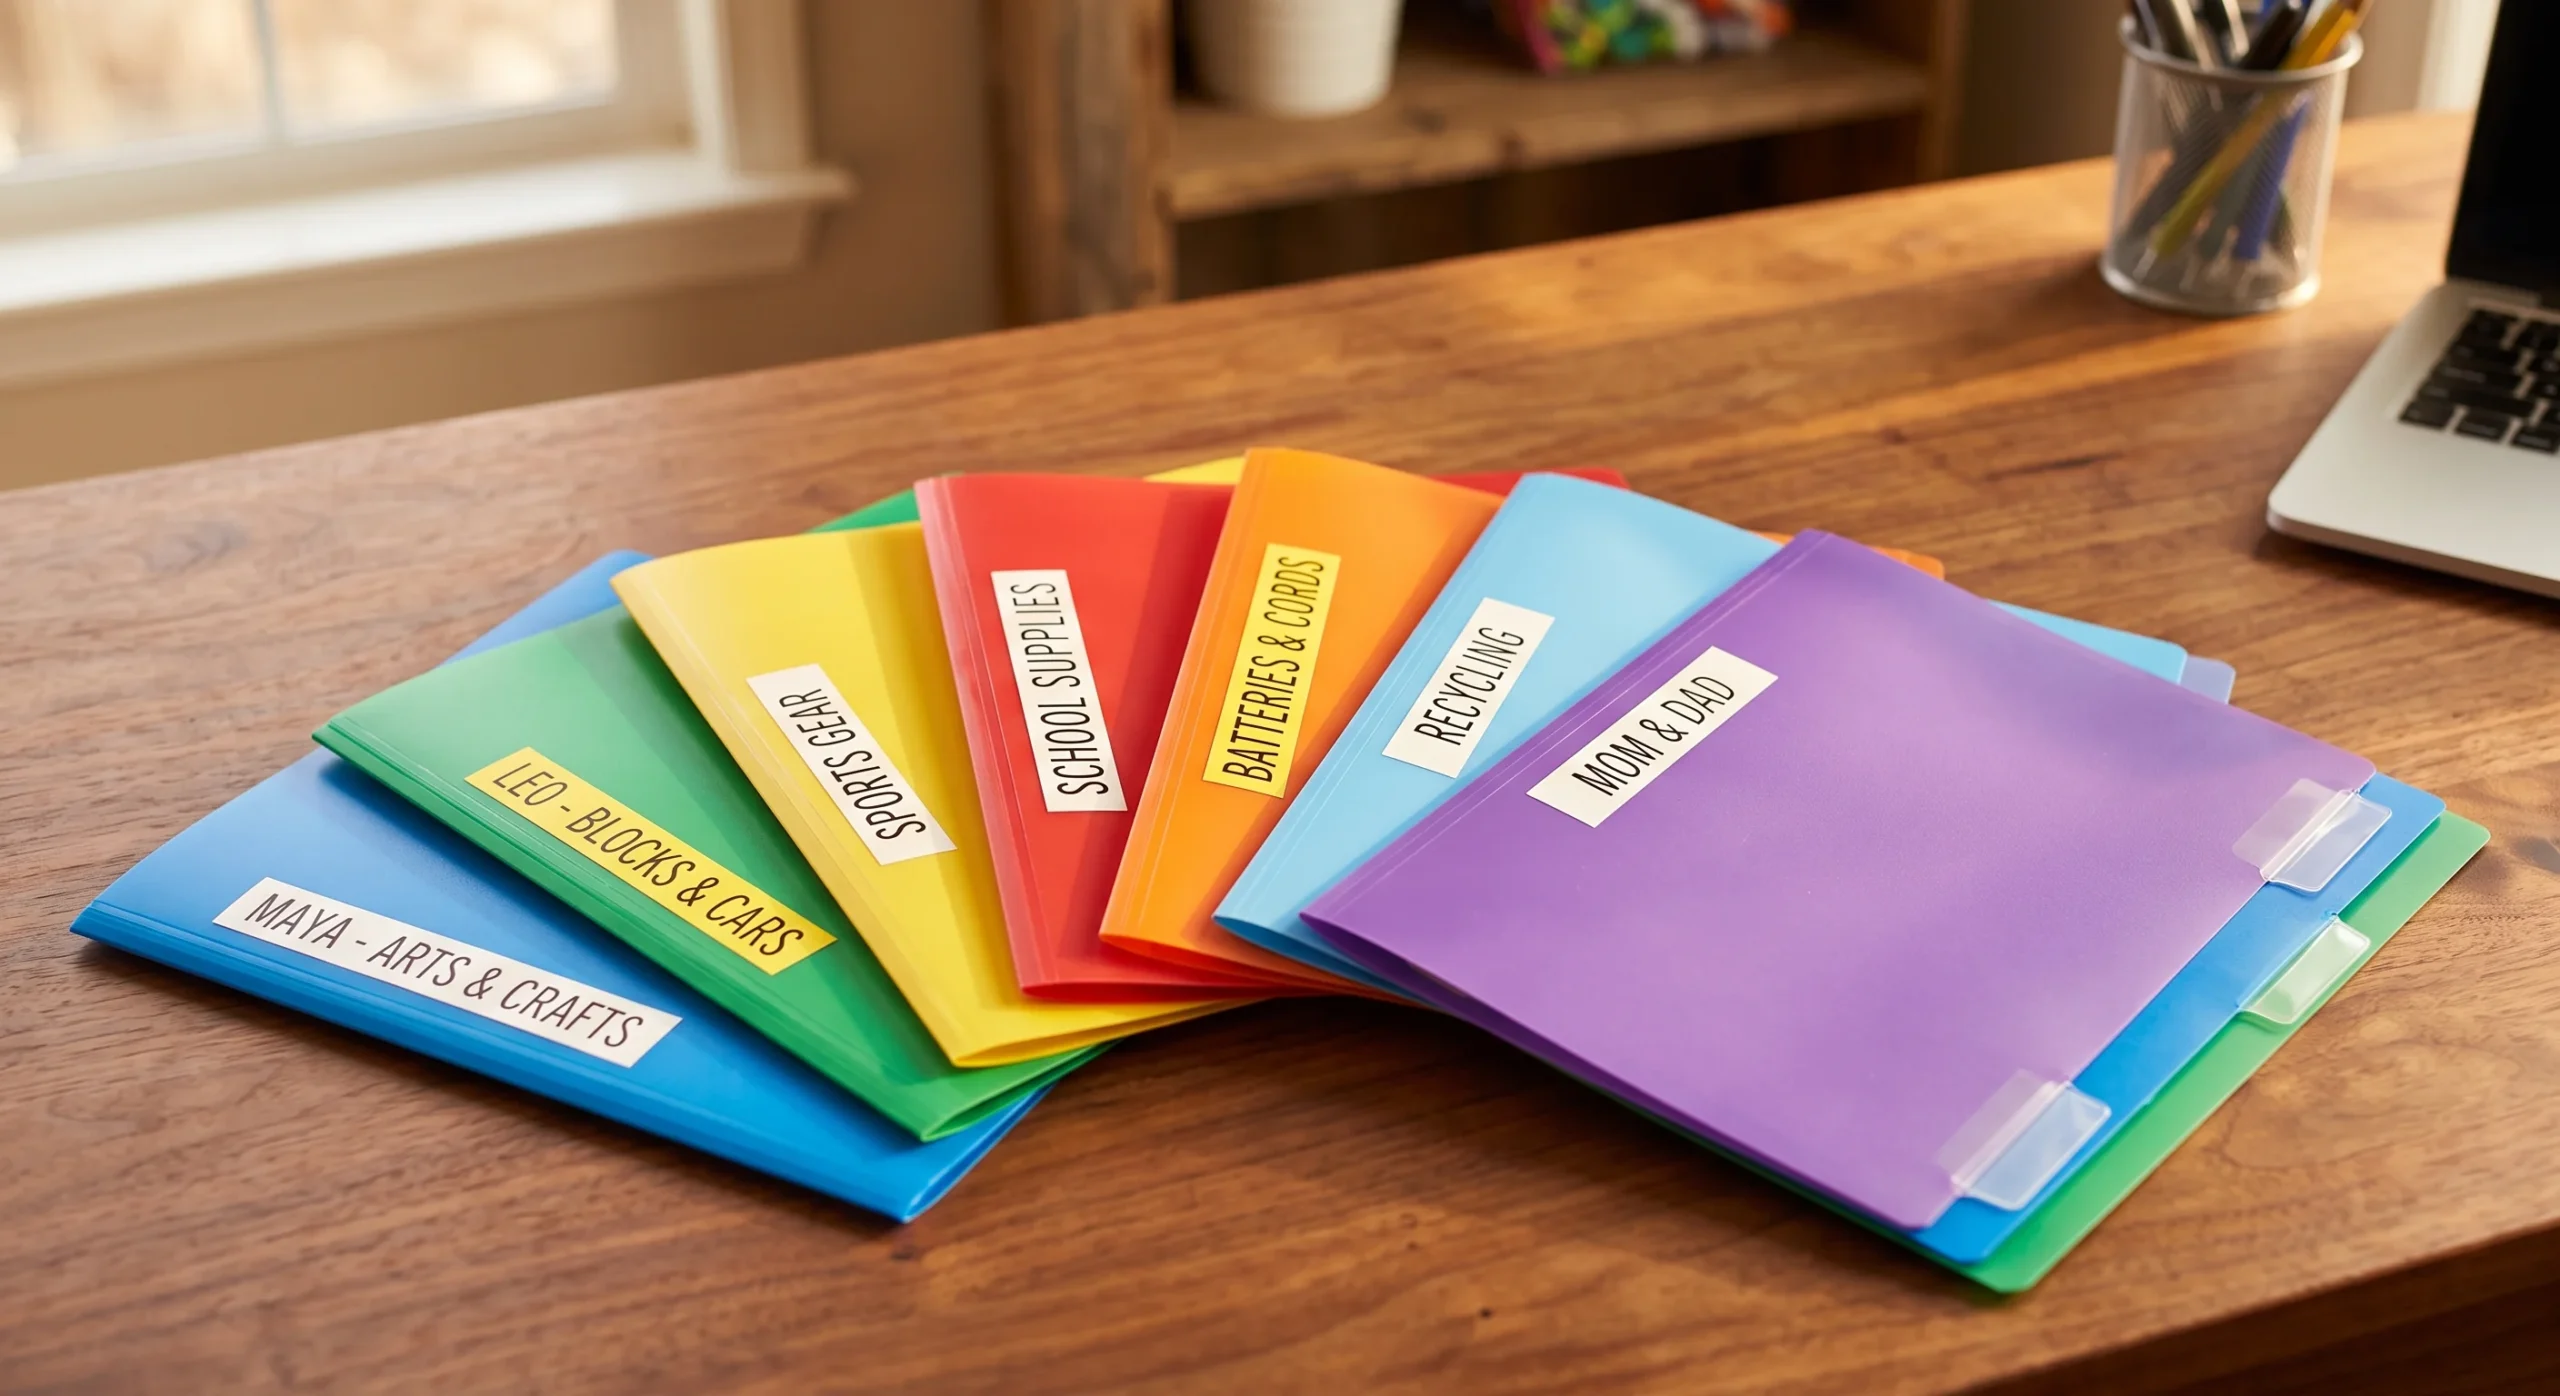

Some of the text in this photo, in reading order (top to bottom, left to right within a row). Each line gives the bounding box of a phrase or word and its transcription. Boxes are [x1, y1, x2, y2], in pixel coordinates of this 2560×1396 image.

[1010, 583, 1109, 795] SCHOOL SUPPLIES
[1221, 555, 1325, 783] BATTERIES & CORDS
[1413, 627, 1525, 746] RECYCLING
[1571, 676, 1735, 797] MOM & DAD
[778, 688, 927, 840] SPORTS GEAR
[492, 762, 568, 806] LEO
[565, 806, 696, 887] BLOCKS
[676, 877, 720, 907] &
[705, 894, 804, 956] CARS
[244, 893, 353, 949] MAYA
[366, 936, 472, 987] ARTS
[463, 967, 503, 1000] &
[500, 979, 644, 1048] CRAFTS
